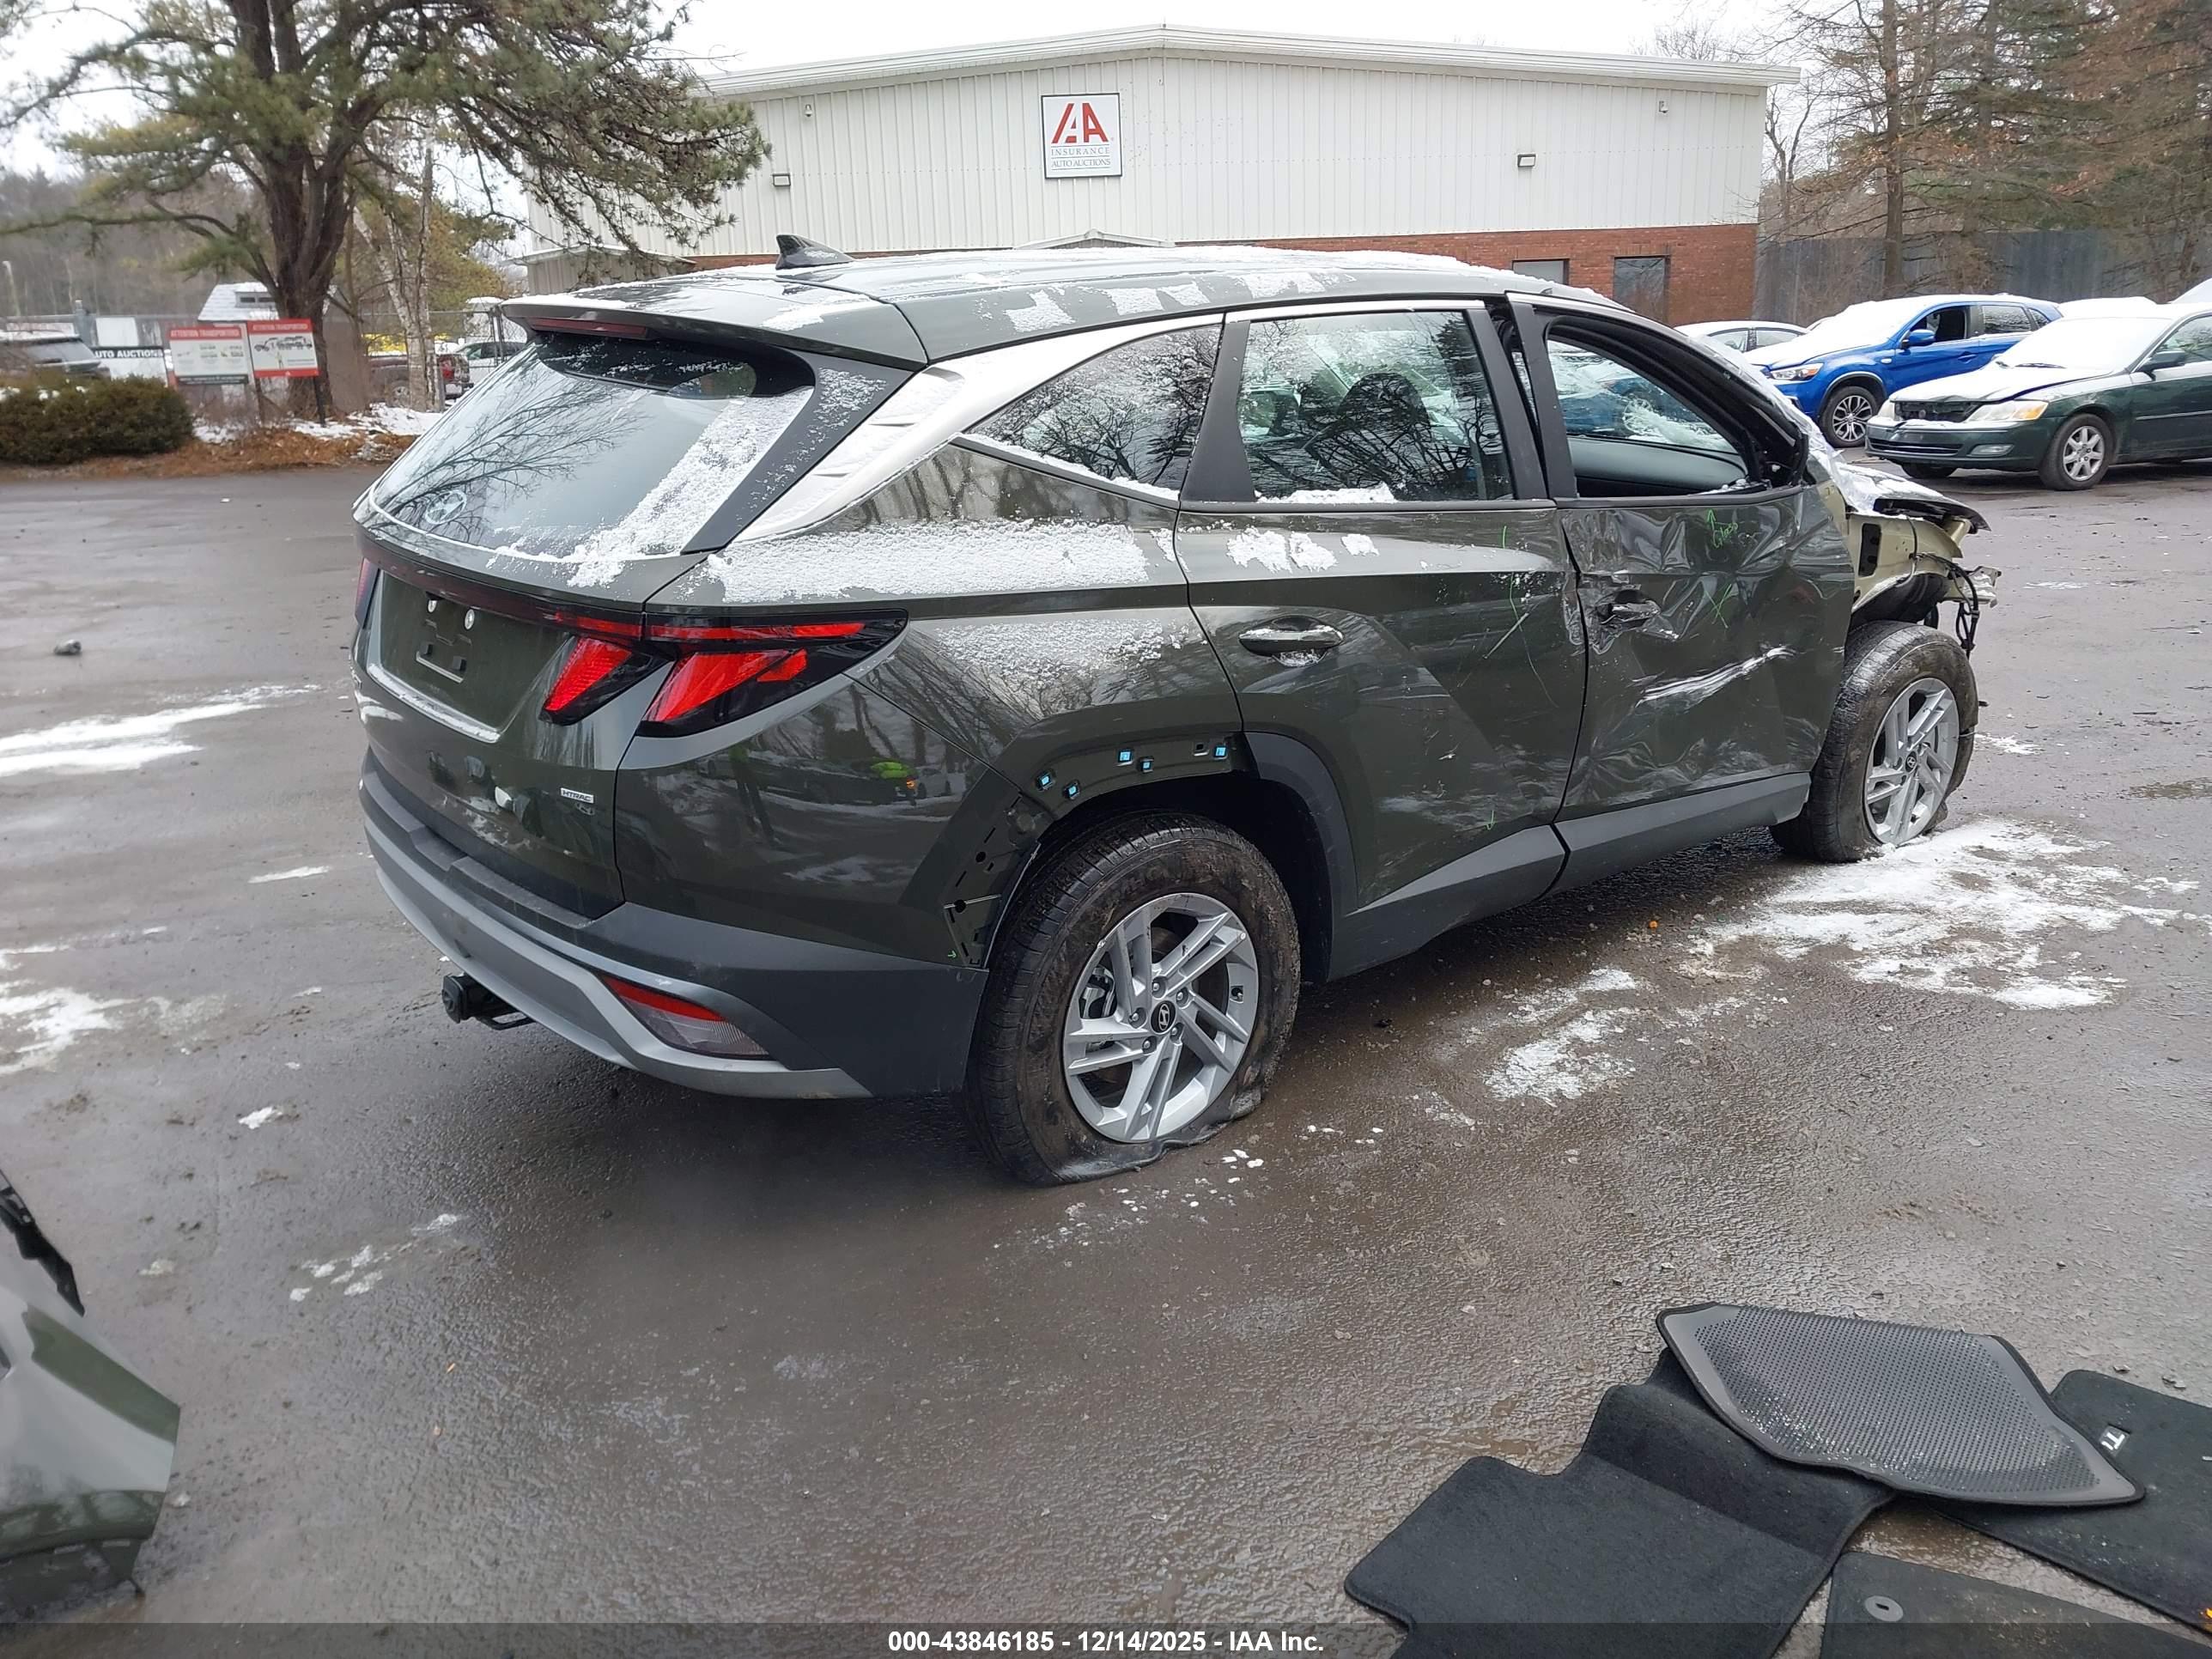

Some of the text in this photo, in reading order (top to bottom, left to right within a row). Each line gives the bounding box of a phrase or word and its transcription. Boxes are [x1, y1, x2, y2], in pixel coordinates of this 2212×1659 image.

[1050, 147, 1110, 156] INSURANCE
[1051, 157, 1111, 168] AUTO AUCTIONS
[562, 789, 592, 803] HTRAC
